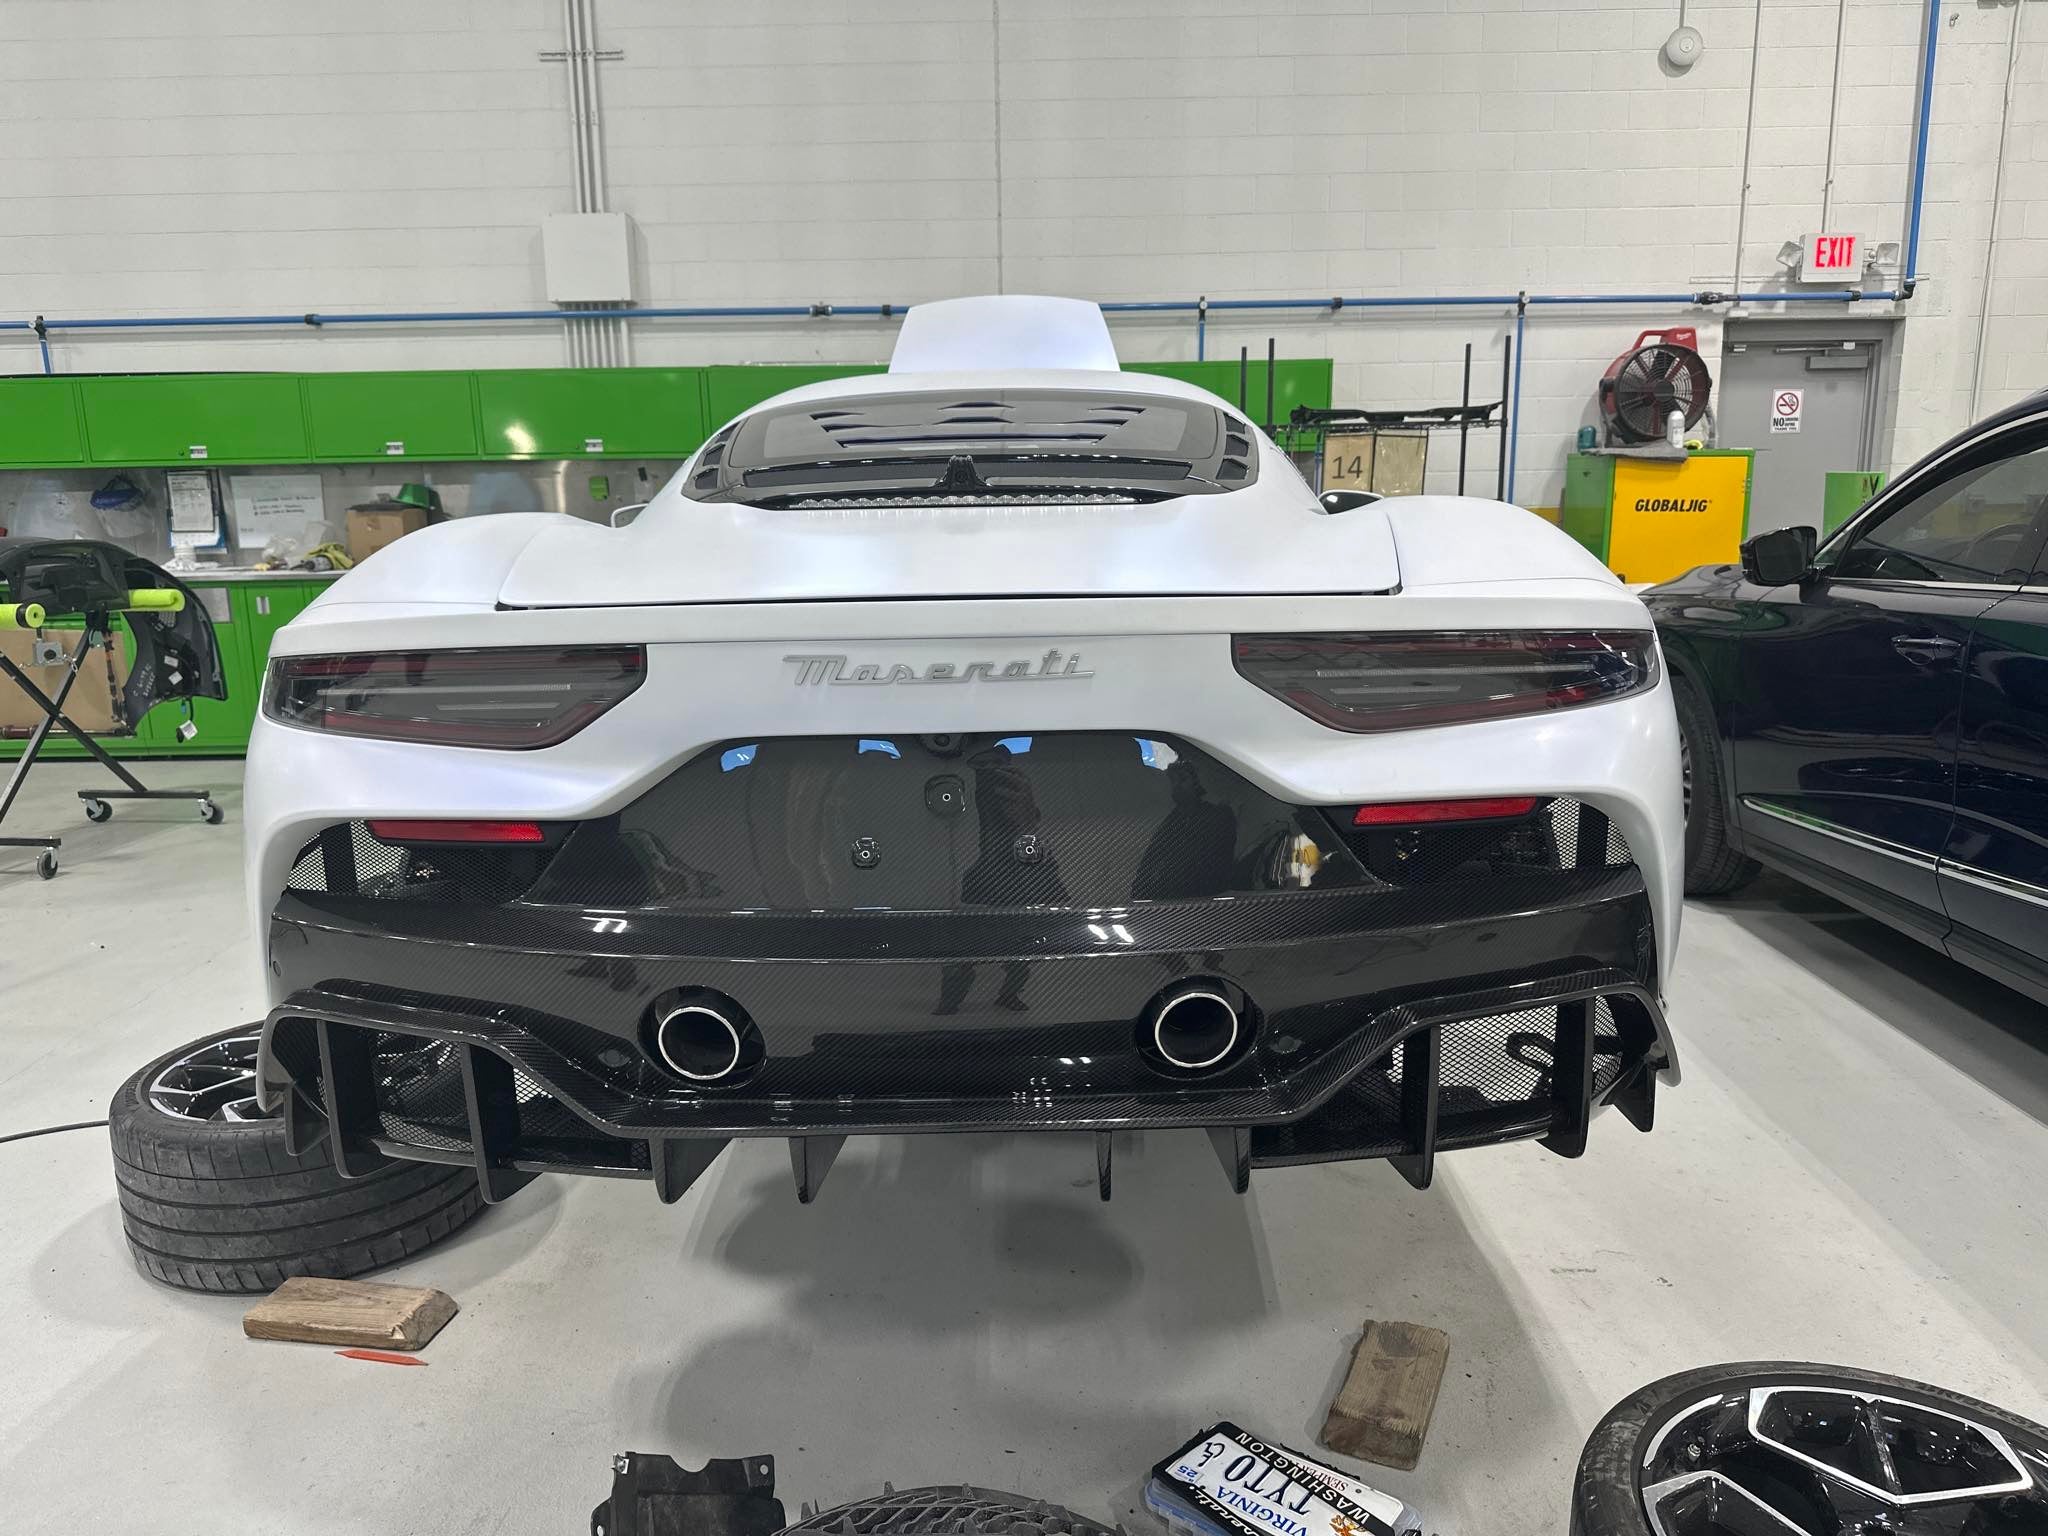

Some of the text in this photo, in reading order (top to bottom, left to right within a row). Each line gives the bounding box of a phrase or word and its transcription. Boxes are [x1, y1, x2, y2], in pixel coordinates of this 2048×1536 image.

[1815, 236, 1856, 268] EXIT
[1773, 417, 1785, 427] NO
[1331, 455, 1364, 480] 14
[1635, 498, 1708, 513] GLOBALJIG
[782, 648, 1096, 686] Maserati
[1177, 1465, 1198, 1478] 25
[1235, 1432, 1370, 1525] WASHINGTON
